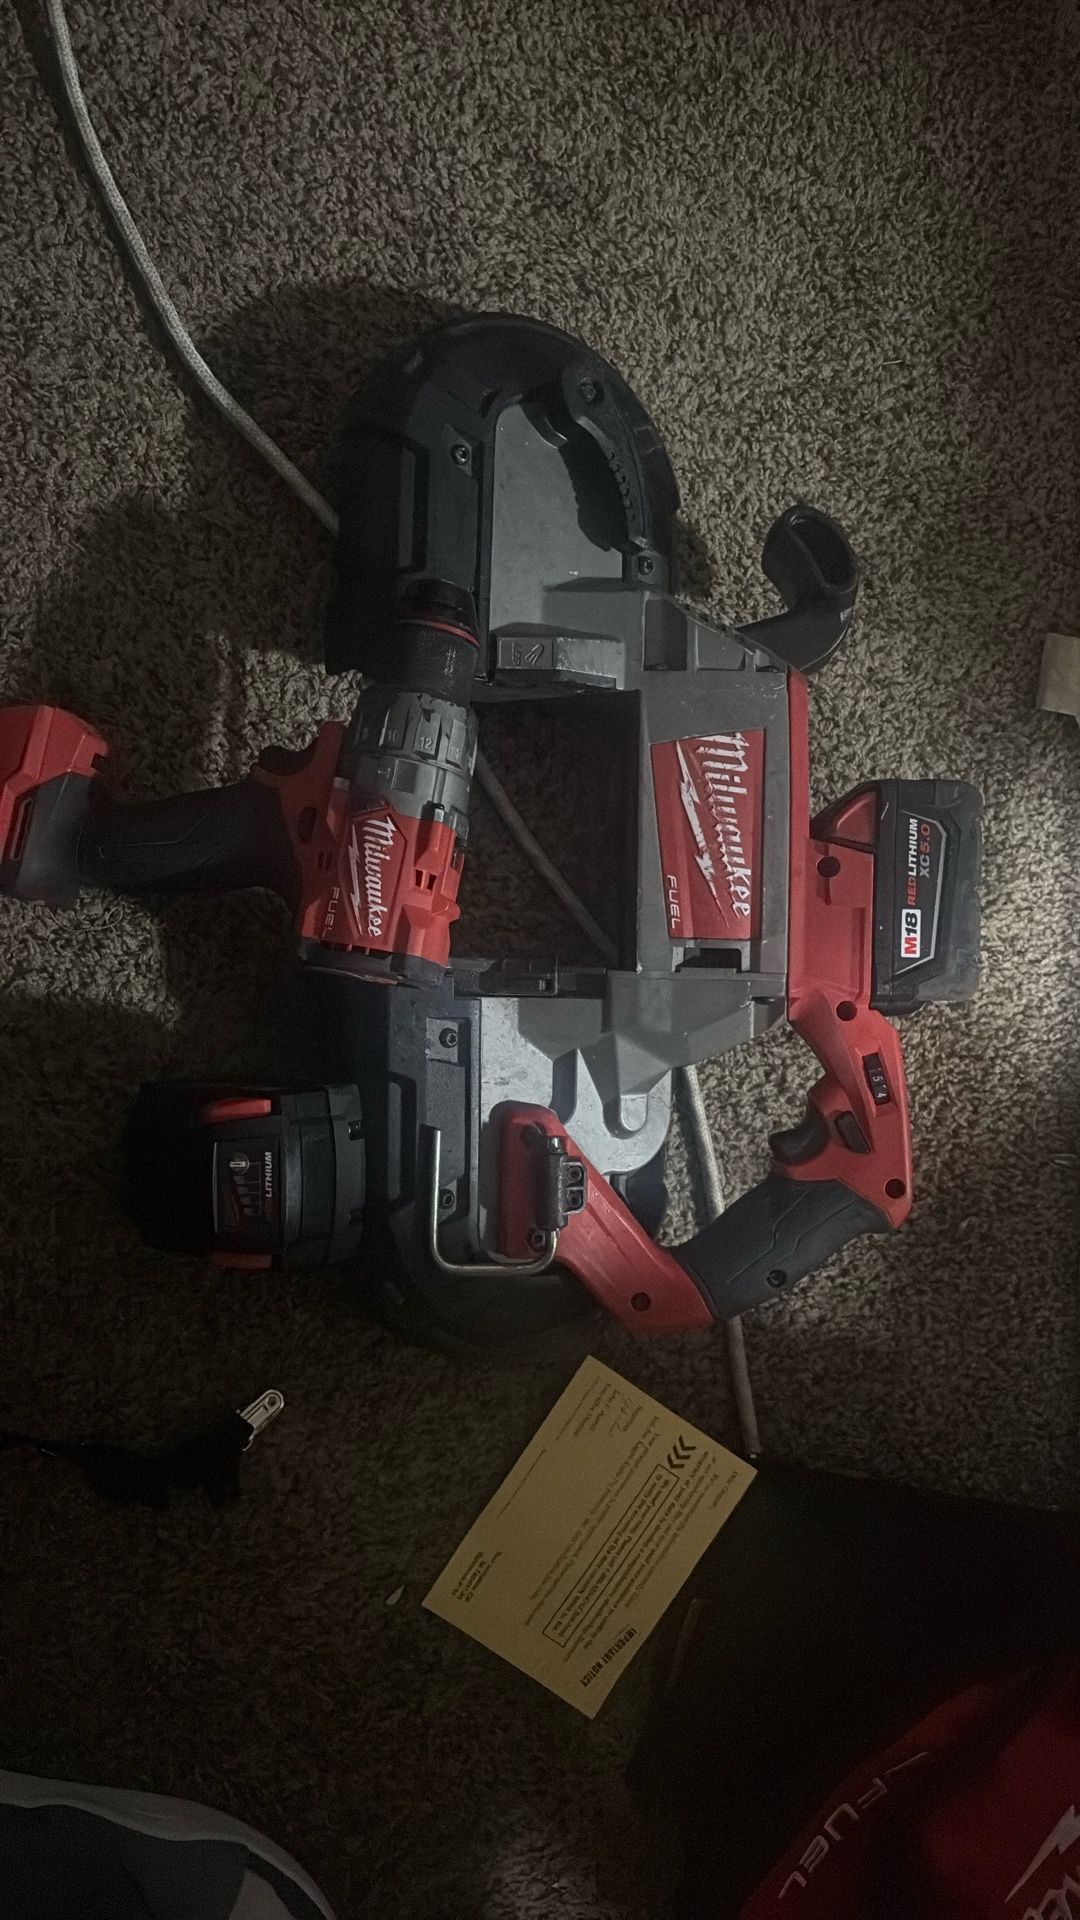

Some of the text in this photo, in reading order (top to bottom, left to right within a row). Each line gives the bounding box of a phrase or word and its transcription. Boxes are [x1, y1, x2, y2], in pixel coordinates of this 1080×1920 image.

[419, 736, 433, 750] 12
[695, 732, 751, 918] Milwaukee
[919, 823, 930, 878] XC5.0
[363, 816, 397, 938] Milwaukee
[666, 874, 680, 930] FUEL
[322, 887, 339, 940] FUEL
[904, 911, 919, 956] M18
[264, 1151, 272, 1198] LITHIUM
[602, 1627, 637, 1664] IMPORTANT
[777, 1777, 887, 1899] FUEL
